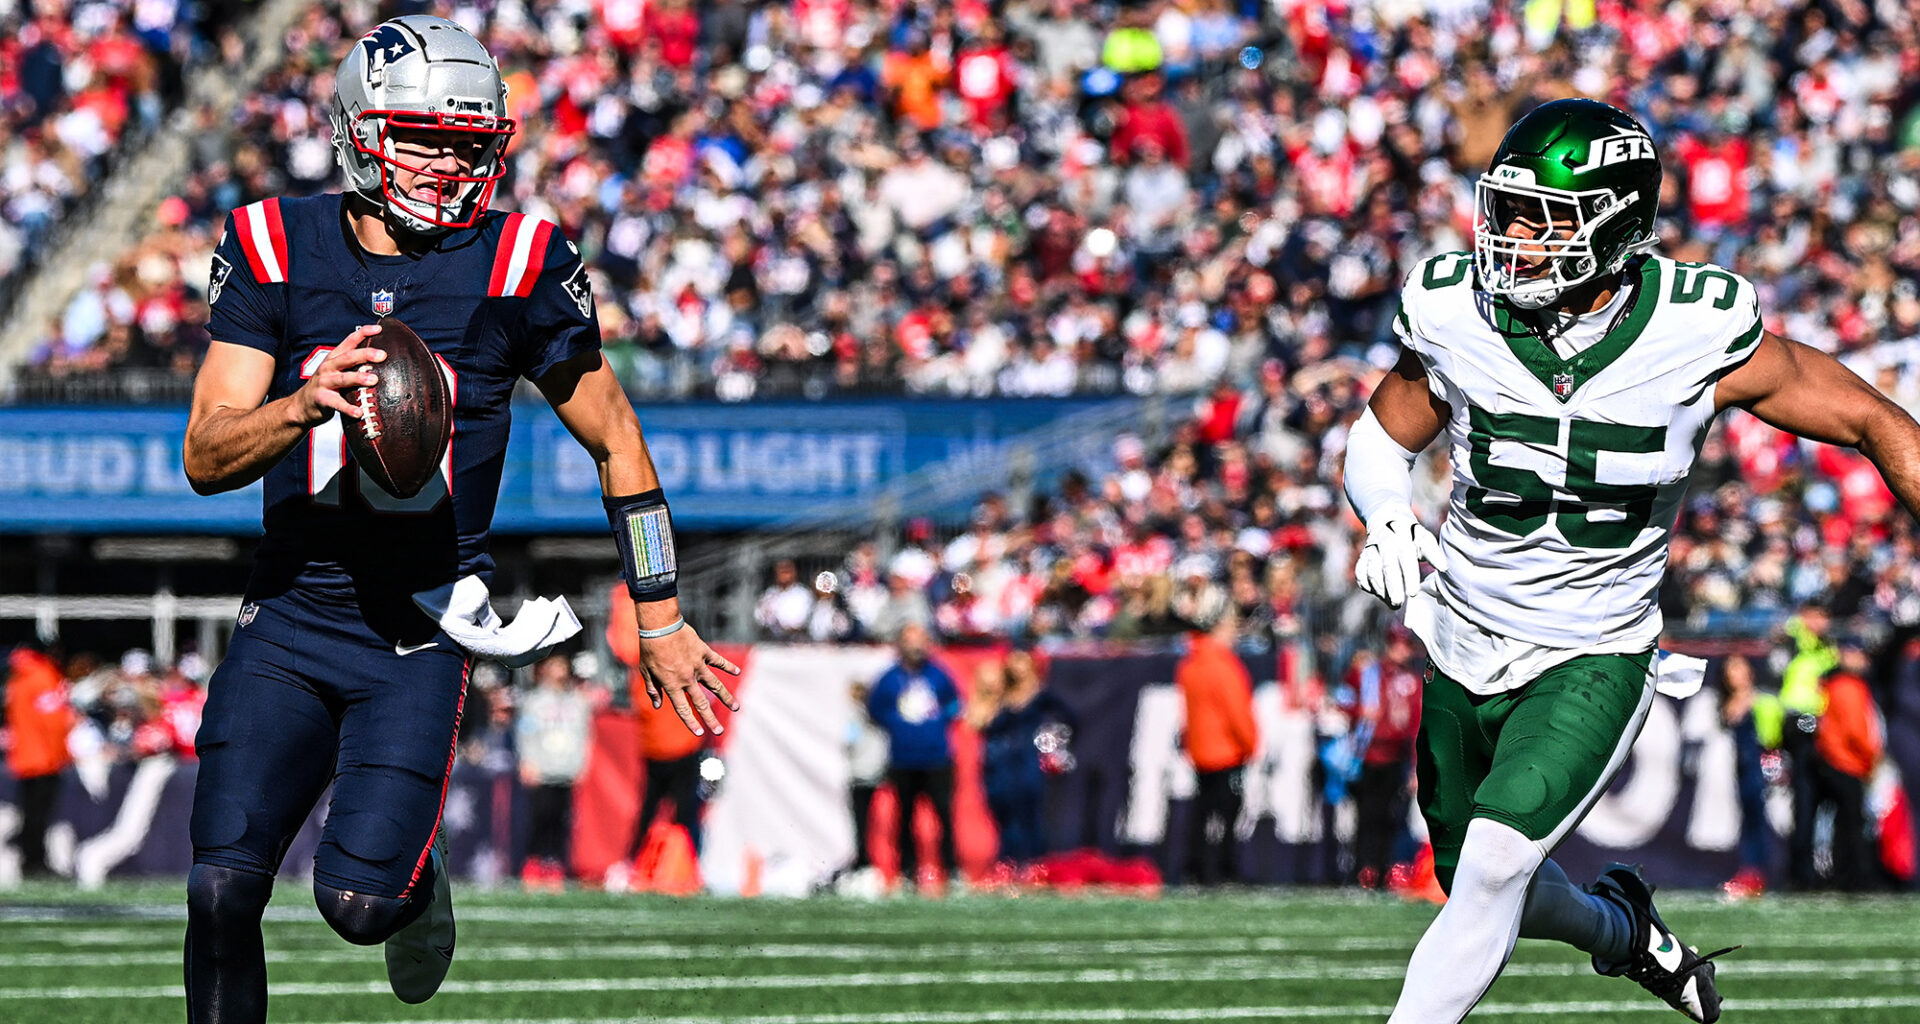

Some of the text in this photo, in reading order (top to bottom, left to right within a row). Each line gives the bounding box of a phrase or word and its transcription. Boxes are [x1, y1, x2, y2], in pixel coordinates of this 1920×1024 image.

[1573, 124, 1656, 175] JETS
[375, 302, 391, 312] NFL
[555, 434, 689, 492] BD
[700, 433, 885, 492] LIGHT
[1465, 404, 1668, 549] 55
